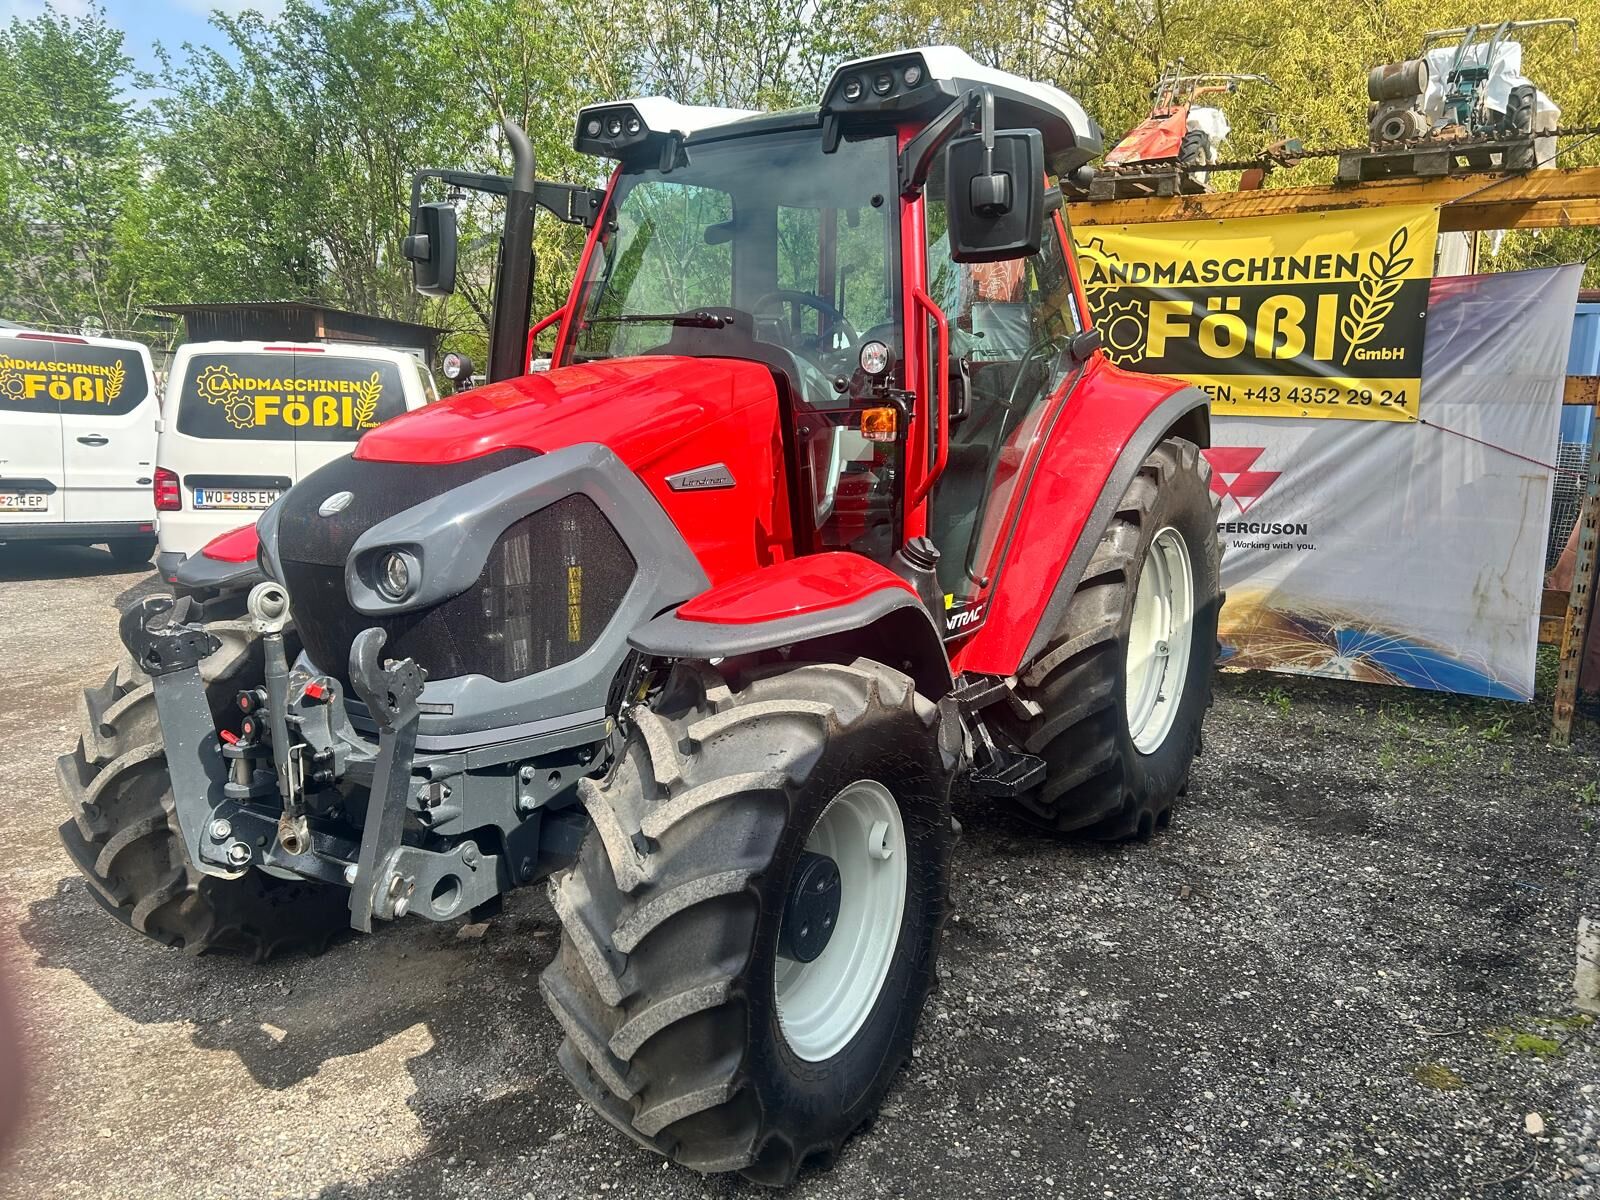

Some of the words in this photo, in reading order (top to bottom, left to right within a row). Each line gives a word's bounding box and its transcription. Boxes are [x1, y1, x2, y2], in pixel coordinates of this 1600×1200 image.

[1083, 253, 1359, 284] ANDMASCHINEN
[1145, 293, 1339, 360] Fößl
[1354, 347, 1405, 361] GmbH
[24, 374, 104, 403] Fößl
[211, 378, 362, 393] LANDMASCHINEN
[1197, 385, 1237, 404] EN,
[1244, 386, 1281, 402] +43
[1287, 387, 1340, 404] 4352
[1346, 388, 1373, 405] 29
[1379, 390, 1408, 407] 24
[254, 395, 352, 427] Fößl
[204, 491, 222, 503] WO
[1216, 522, 1307, 535] FERGUSON
[1233, 540, 1270, 550] Working
[1272, 541, 1293, 550] with
[1296, 543, 1317, 551] you.
